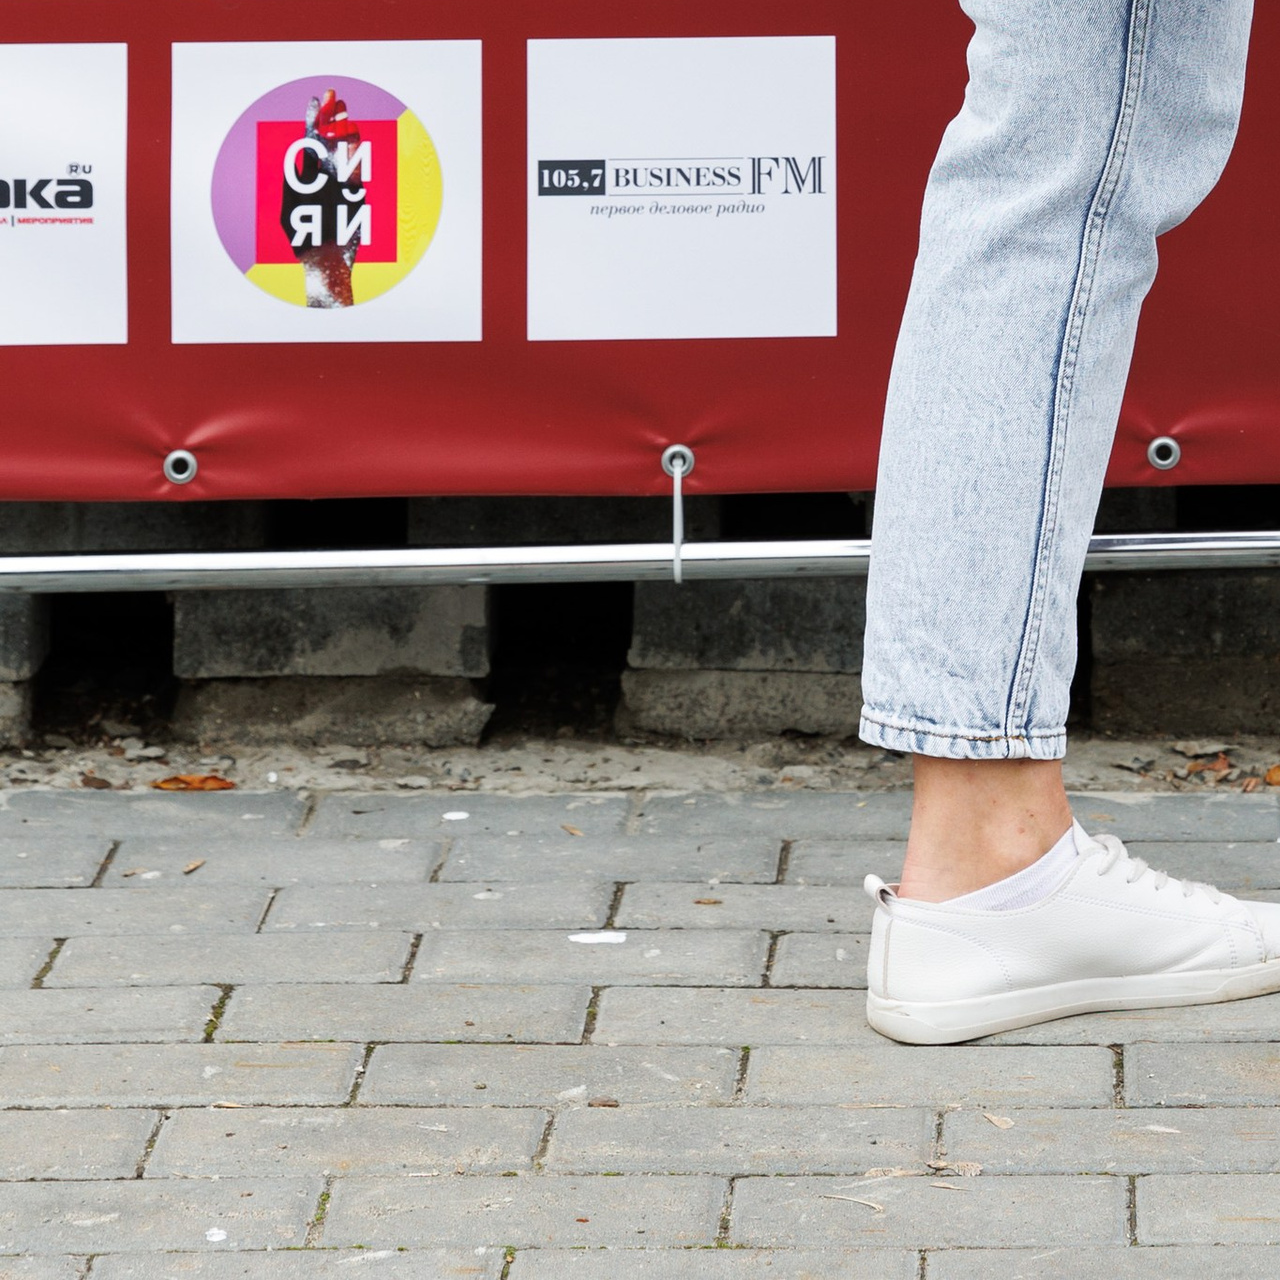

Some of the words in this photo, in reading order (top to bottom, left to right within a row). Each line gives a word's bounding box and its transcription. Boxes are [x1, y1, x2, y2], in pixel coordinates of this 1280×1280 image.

[541, 167, 603, 192] 105,7
[612, 166, 742, 190] BUSINESS
[747, 156, 826, 195] FM
[590, 202, 644, 219] первое
[648, 198, 713, 217] деловое
[716, 199, 766, 218] радио
